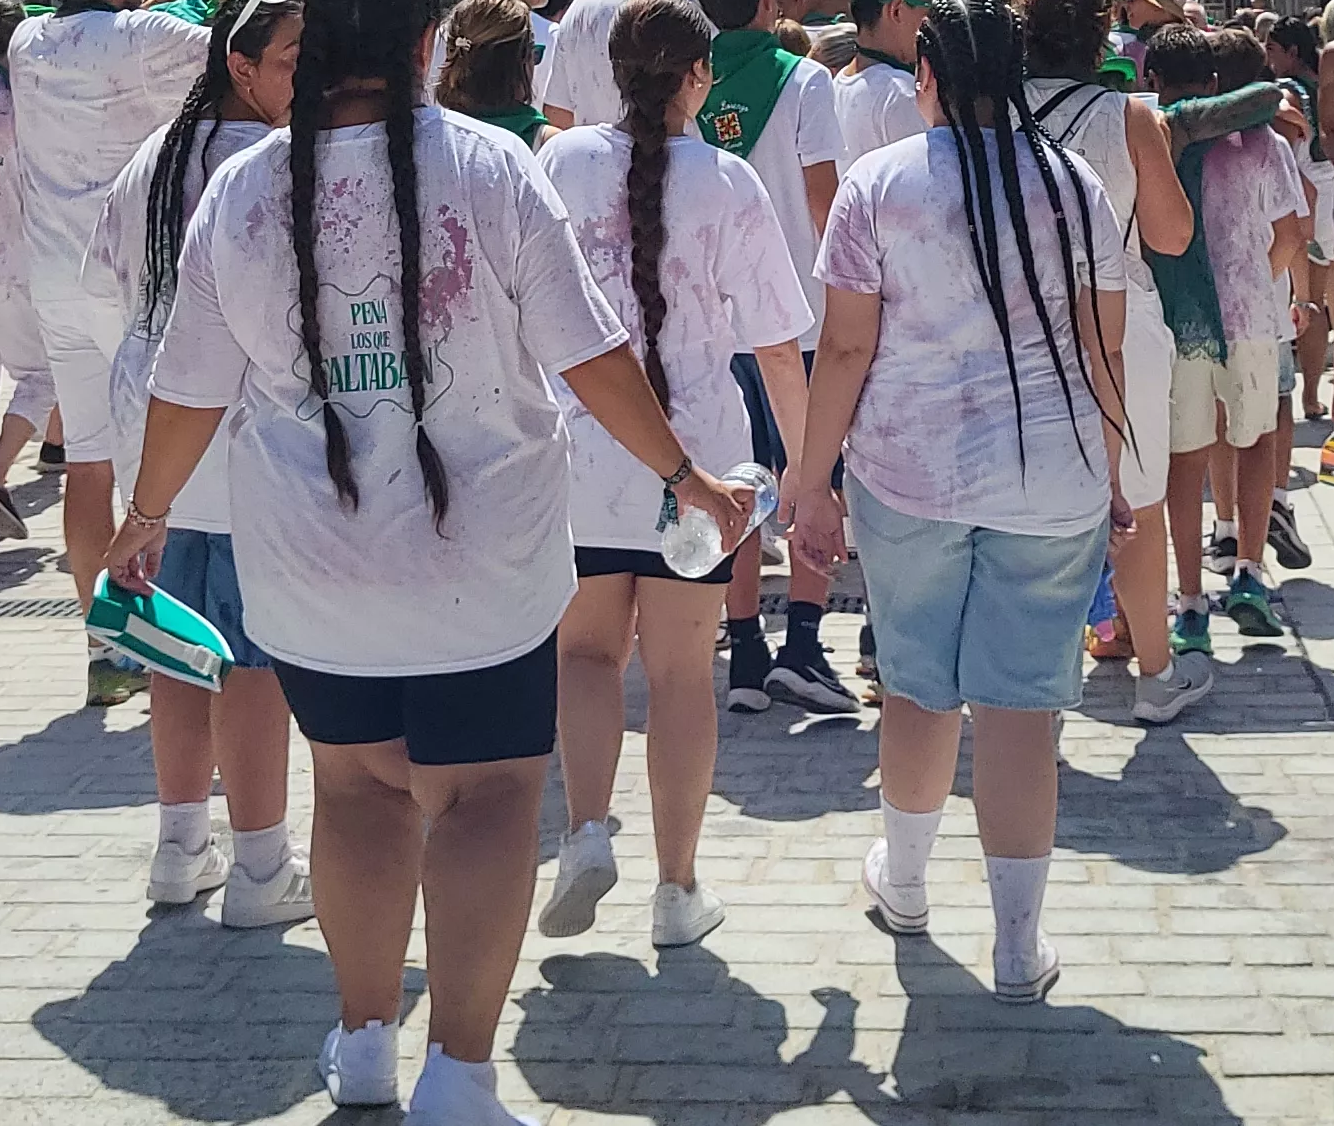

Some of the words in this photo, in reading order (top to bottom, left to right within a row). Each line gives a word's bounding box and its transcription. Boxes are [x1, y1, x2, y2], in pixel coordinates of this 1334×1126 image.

[350, 298, 388, 325] PEÑA
[350, 332, 371, 349] LOS
[374, 331, 391, 350] QUE
[322, 347, 433, 393] ALTABAN
